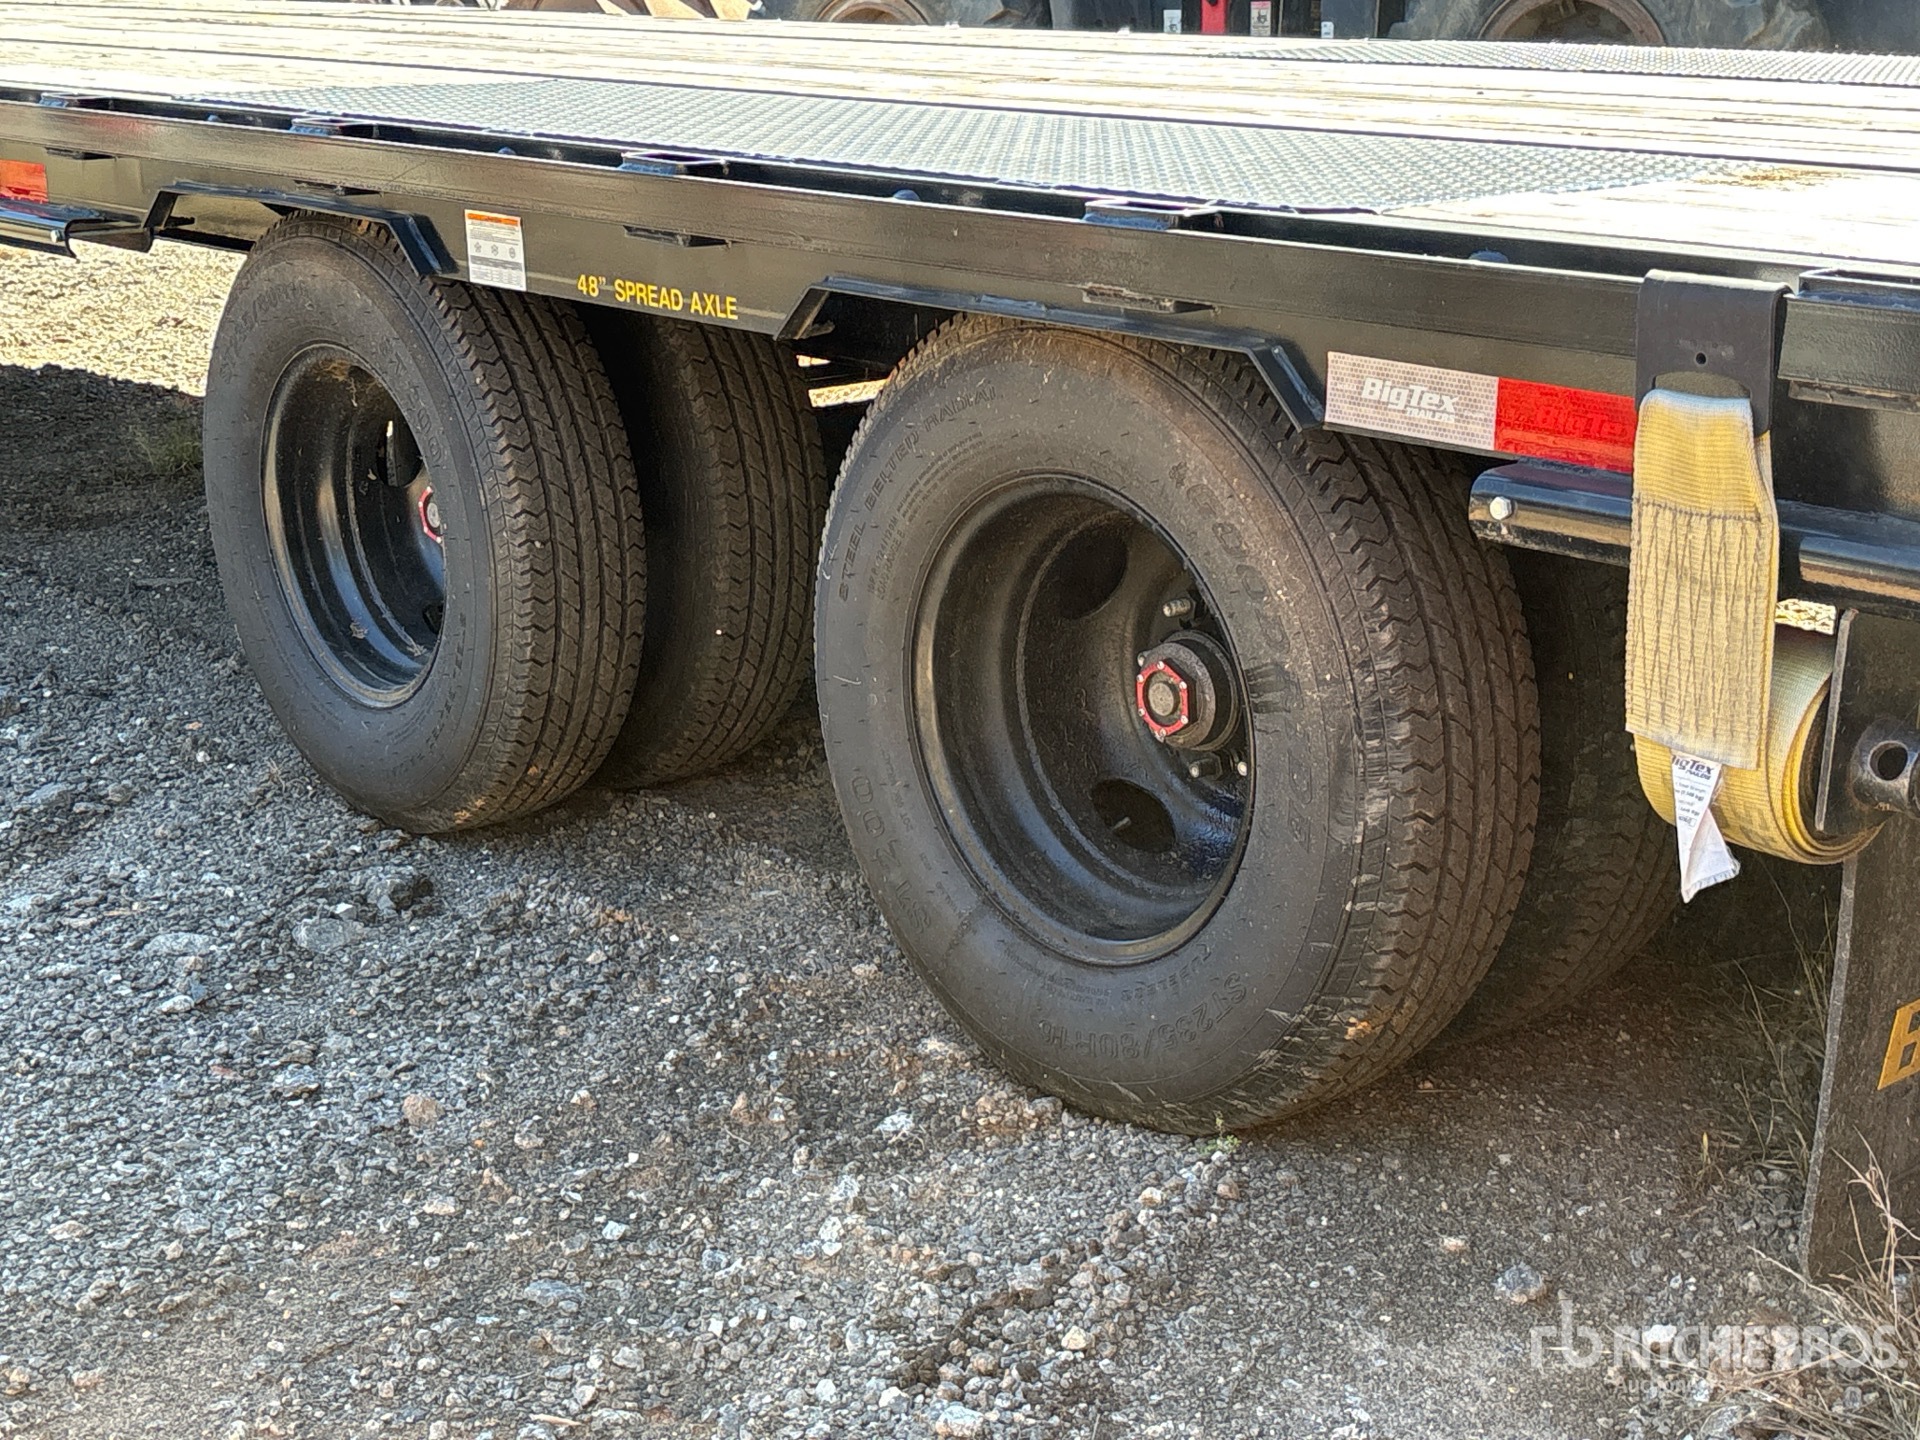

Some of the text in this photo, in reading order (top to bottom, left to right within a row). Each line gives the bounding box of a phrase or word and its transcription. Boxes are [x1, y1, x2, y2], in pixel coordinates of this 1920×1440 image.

[614, 279, 684, 311] SPREAD
[690, 291, 739, 320] AXLE
[1361, 376, 1459, 415] BigTex
[1405, 406, 1456, 424] TRAILERS
[838, 522, 867, 602] STEEL
[865, 430, 920, 512] BELTED
[923, 386, 998, 432] RADIAL
